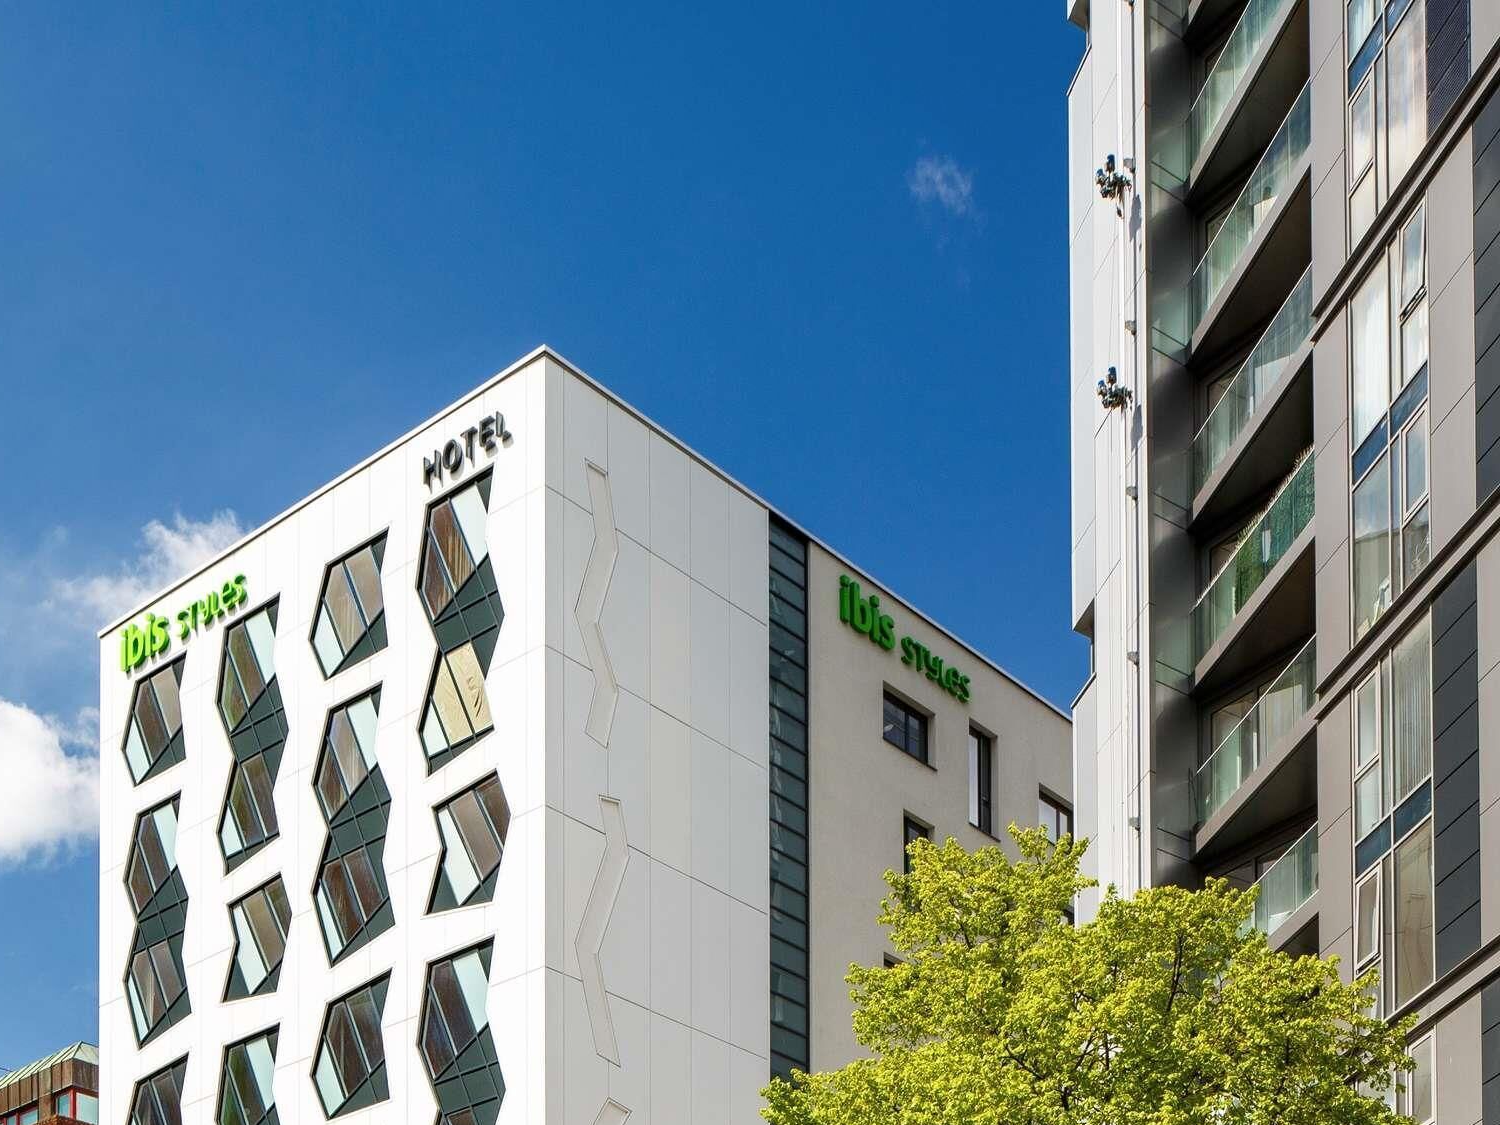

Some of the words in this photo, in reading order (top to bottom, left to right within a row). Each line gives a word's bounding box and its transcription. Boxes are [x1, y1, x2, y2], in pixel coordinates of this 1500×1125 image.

[423, 411, 512, 487] HOTEL
[120, 612, 170, 673] ibis
[839, 574, 896, 650] ibis
